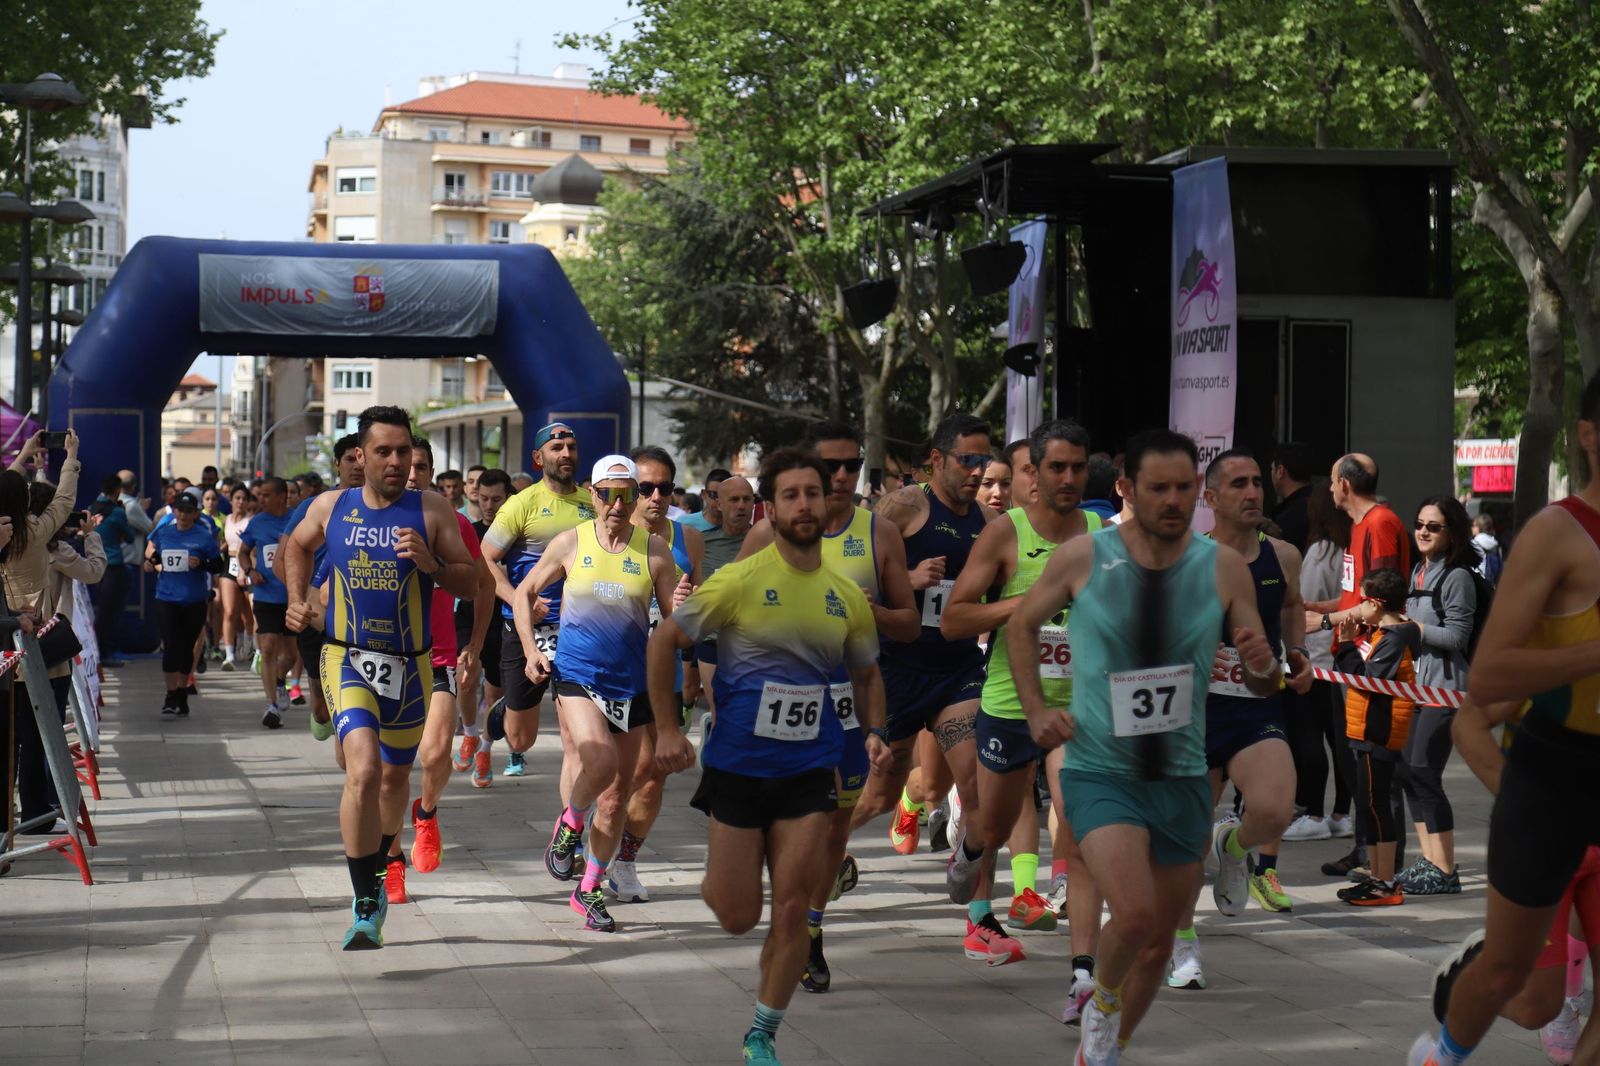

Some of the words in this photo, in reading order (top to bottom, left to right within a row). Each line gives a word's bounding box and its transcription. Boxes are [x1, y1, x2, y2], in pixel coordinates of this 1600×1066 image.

[240, 272, 275, 284] NOS
[240, 287, 330, 305] IMPULSA
[439, 301, 462, 312] de
[1175, 324, 1231, 357] NVASPORT
[1198, 446, 1221, 462] GHT
[1466, 446, 1483, 459] POR
[345, 526, 401, 548] JESUS
[267, 552, 274, 561] 2
[843, 549, 865, 557] DUERO
[167, 556, 182, 567] 87
[622, 568, 641, 576] DUERO
[350, 577, 399, 591] DUERO
[593, 582, 625, 599] PRIETO
[362, 660, 392, 685] 92
[1137, 673, 1168, 681] CASTILLA
[833, 697, 853, 720] 8
[1132, 685, 1177, 719] 37
[768, 700, 818, 727] 156
[981, 748, 1008, 764] Adarsa
